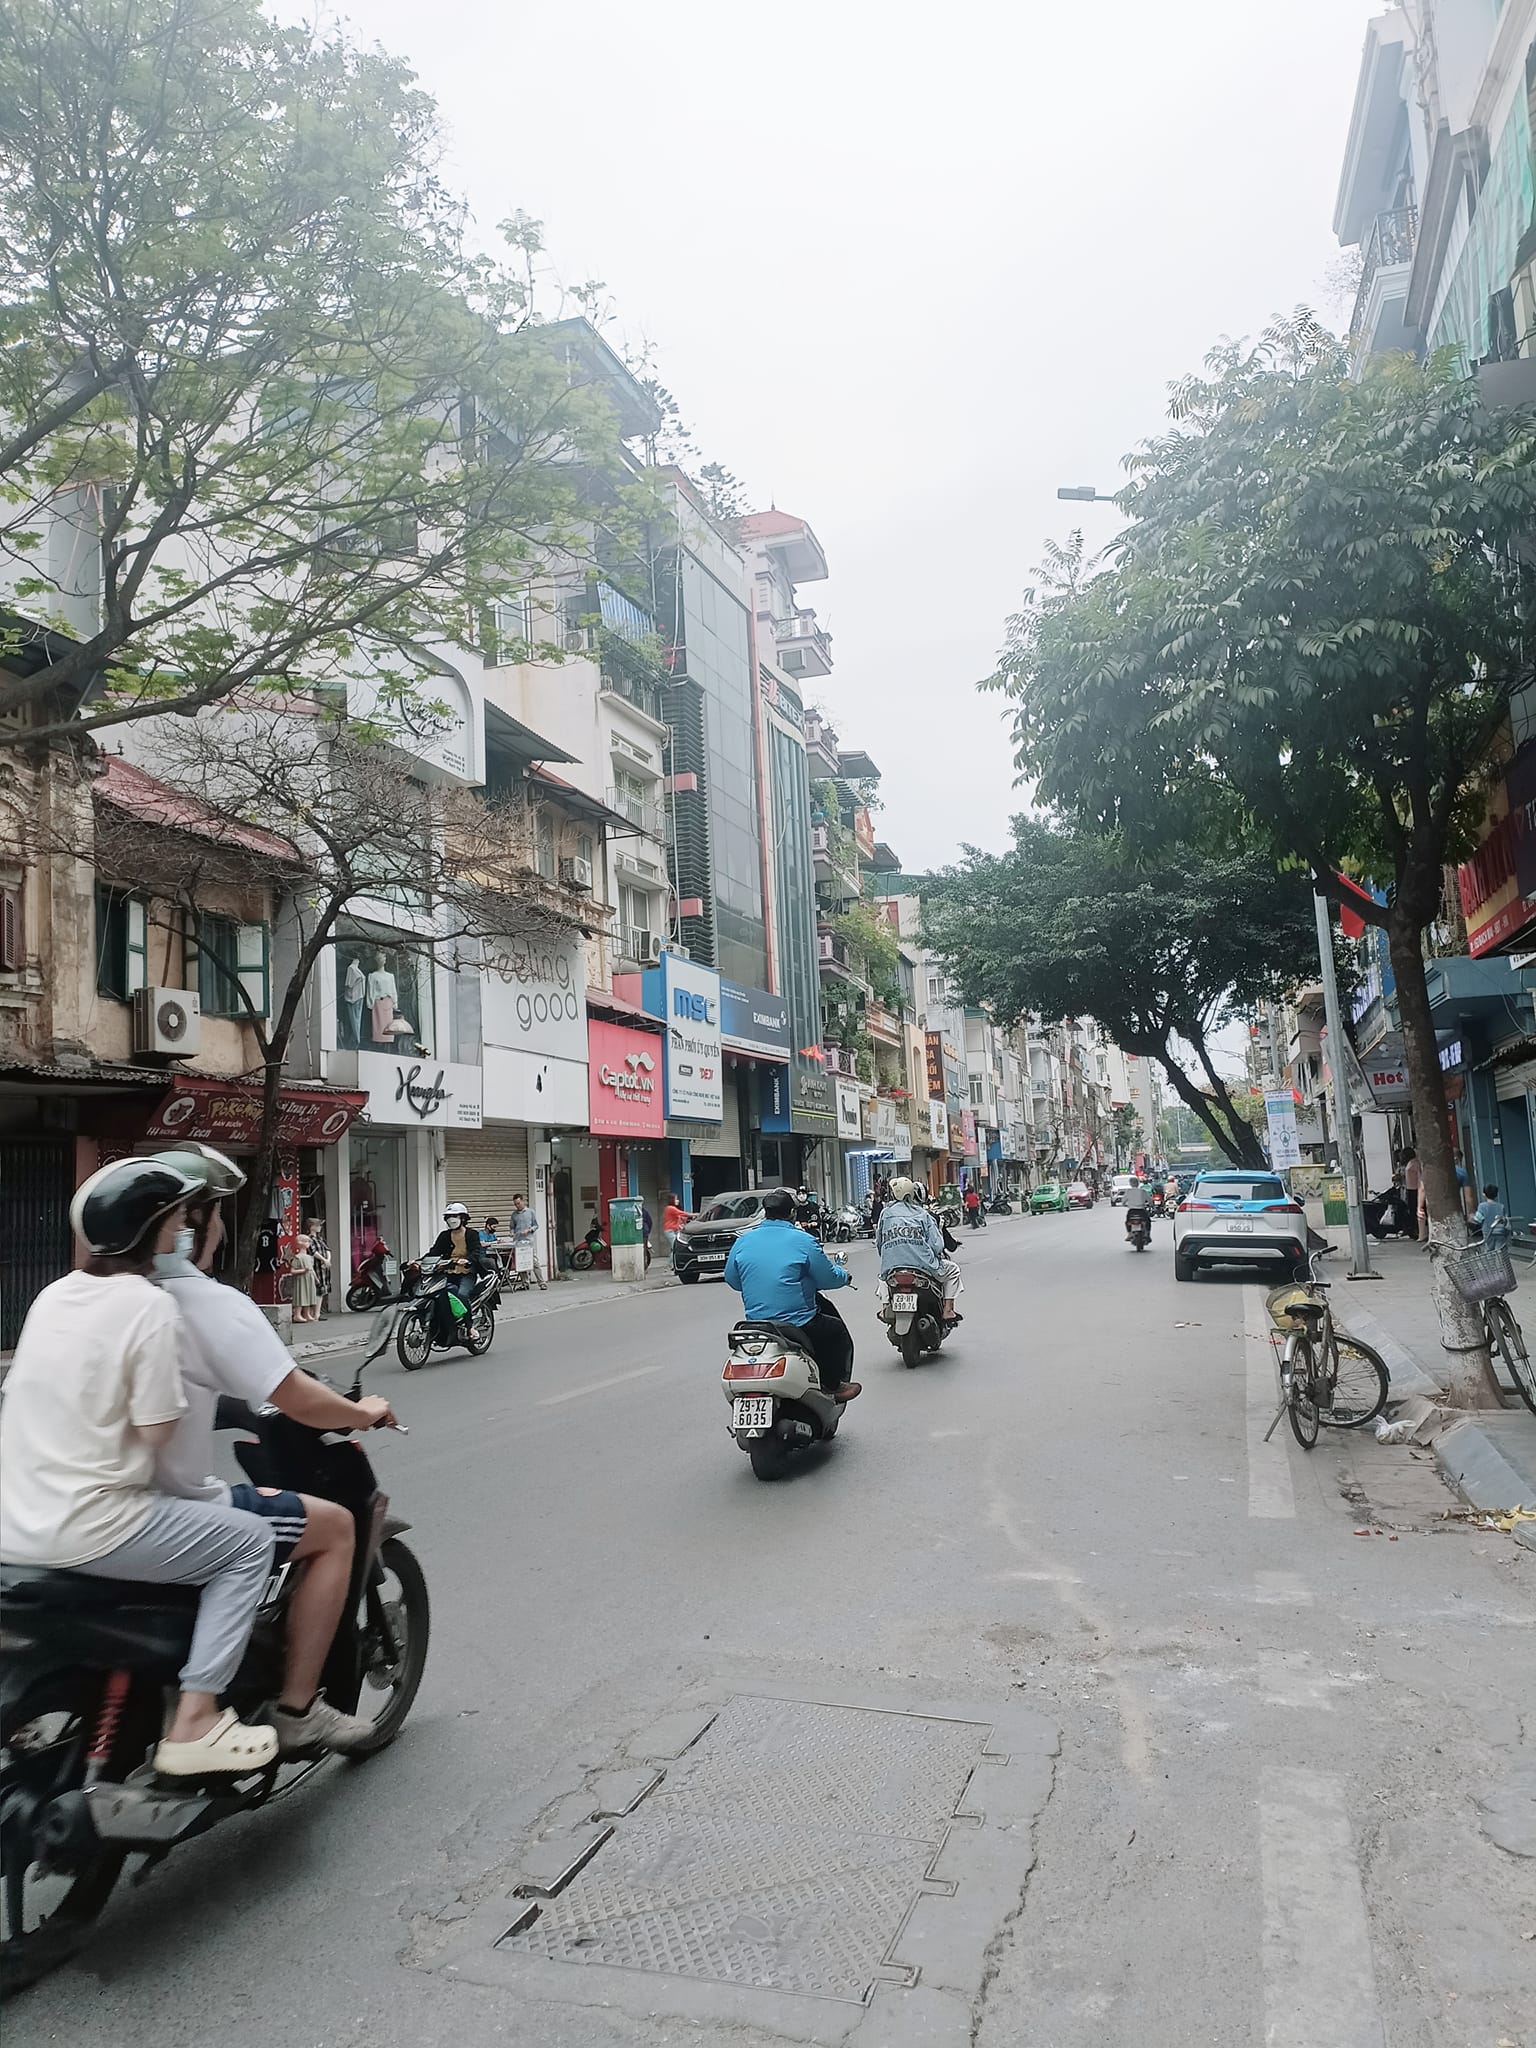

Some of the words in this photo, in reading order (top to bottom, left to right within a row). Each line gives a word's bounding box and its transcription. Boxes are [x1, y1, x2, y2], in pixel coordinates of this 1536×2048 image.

[516, 979, 578, 1031] good
[753, 1012, 781, 1029] EXIMBANK
[1374, 1072, 1404, 1086] Hot
[740, 1400, 767, 1413] 29-X2
[739, 1412, 766, 1426] 6035
